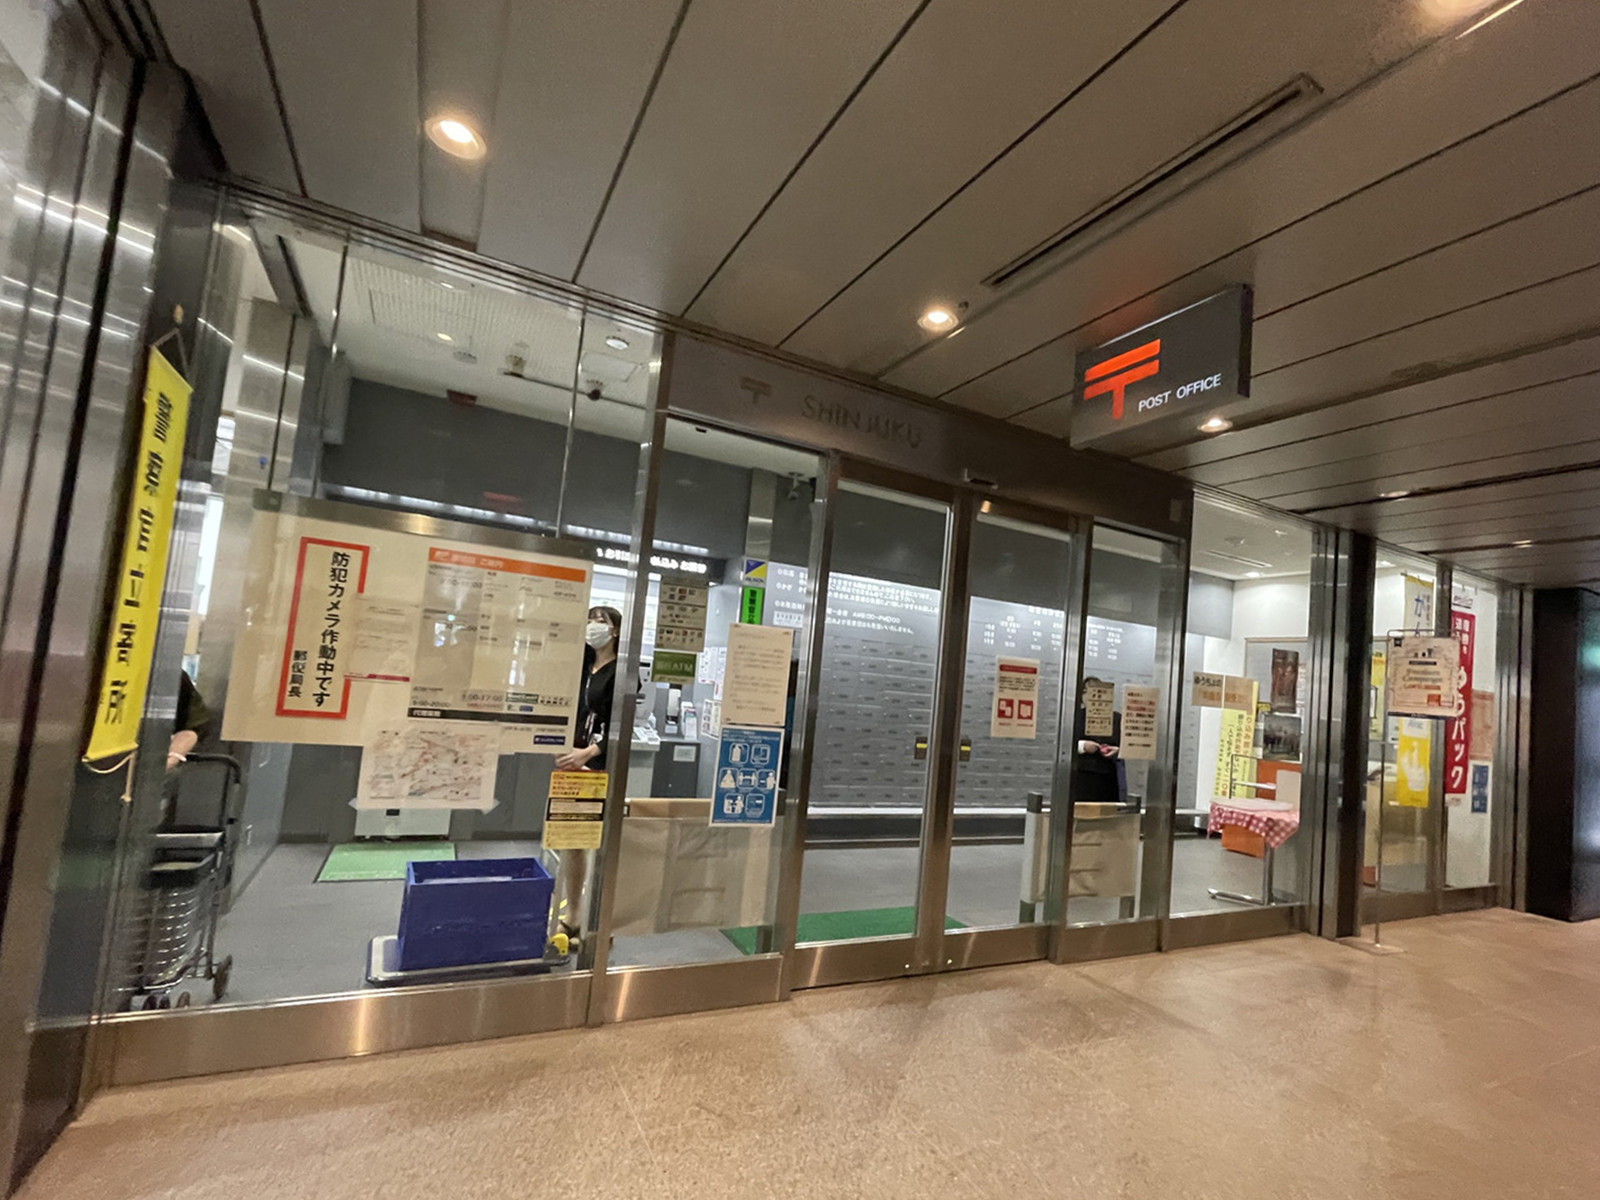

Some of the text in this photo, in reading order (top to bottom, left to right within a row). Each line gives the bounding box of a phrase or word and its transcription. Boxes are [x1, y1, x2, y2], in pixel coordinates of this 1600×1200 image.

[801, 394, 922, 449] SHINJUKU
[1138, 373, 1221, 412] POST OFFICE
[104, 391, 173, 724] 警察官立寄所
[312, 551, 350, 708] 防犯カメラ作動中です
[288, 650, 307, 698] 郵便局長
[1451, 667, 1468, 789] ゆうパック
